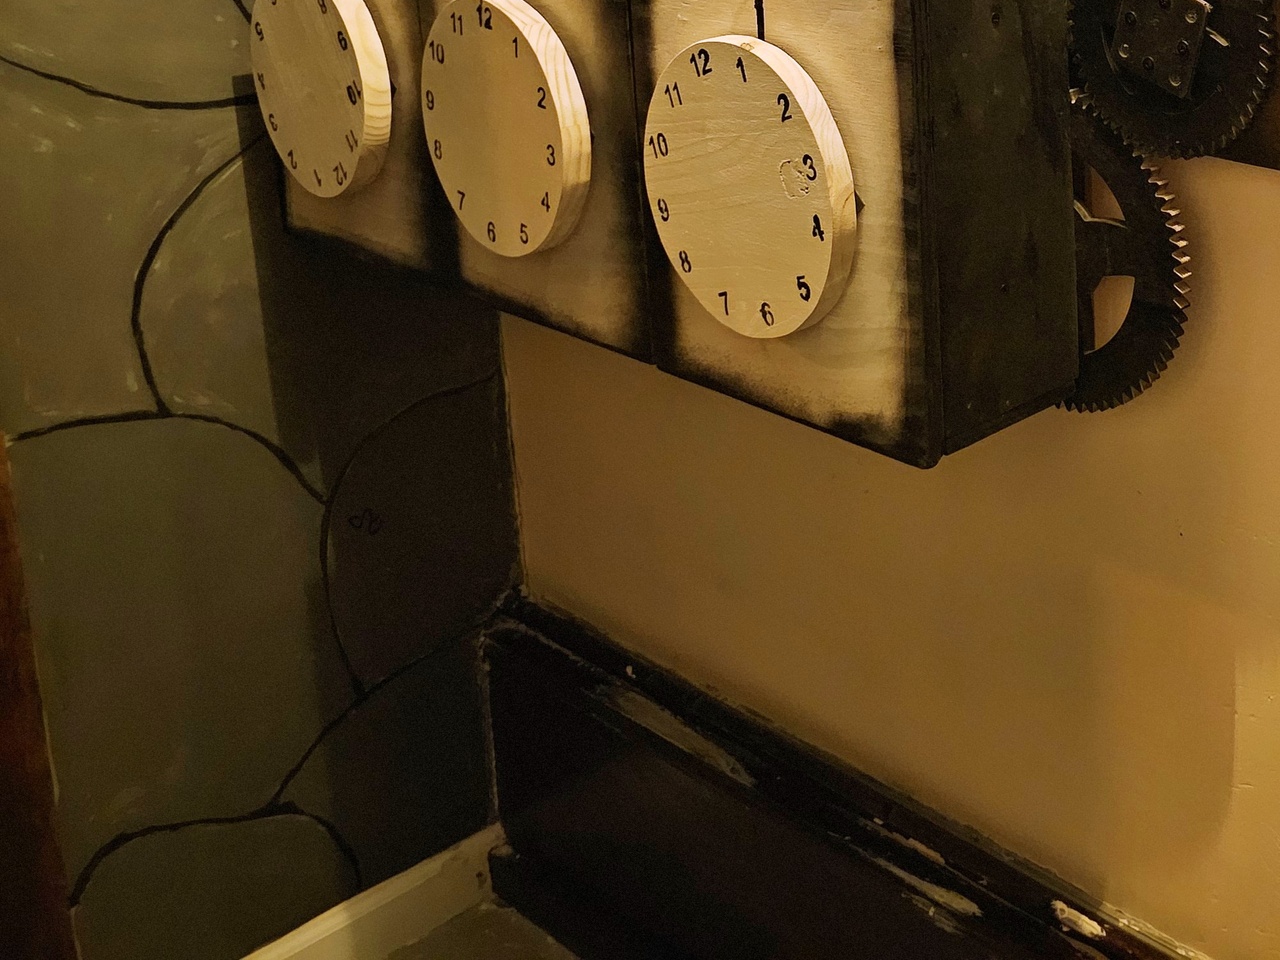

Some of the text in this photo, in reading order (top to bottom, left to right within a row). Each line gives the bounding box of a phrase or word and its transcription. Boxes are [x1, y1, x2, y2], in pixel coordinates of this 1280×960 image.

[450, 12, 463, 36] 11
[476, 1, 492, 30] 12
[254, 21, 265, 42] 5
[337, 30, 348, 51] 9
[429, 41, 444, 64] 10
[512, 36, 518, 59] 1
[690, 49, 712, 77] 12
[735, 56, 747, 83] 1
[347, 81, 361, 105] 10
[425, 89, 435, 111] 9
[536, 86, 548, 110] 2
[665, 82, 682, 107] 11
[778, 94, 792, 122] 2
[268, 113, 278, 133] 3
[345, 129, 359, 153] 11
[433, 139, 443, 160] 8
[649, 133, 668, 158] 10
[286, 149, 298, 171] 2
[546, 144, 556, 167] 3
[802, 153, 817, 181] 3
[313, 169, 322, 187] 1
[333, 162, 348, 186] 12
[456, 189, 467, 211] 7
[540, 191, 552, 214] 4
[657, 198, 670, 222] 9
[487, 221, 496, 243] 6
[519, 222, 529, 245] 5
[811, 214, 825, 242] 4
[679, 250, 692, 274] 8
[796, 275, 811, 303] 5
[717, 290, 729, 316] 7
[760, 303, 774, 326] 6
